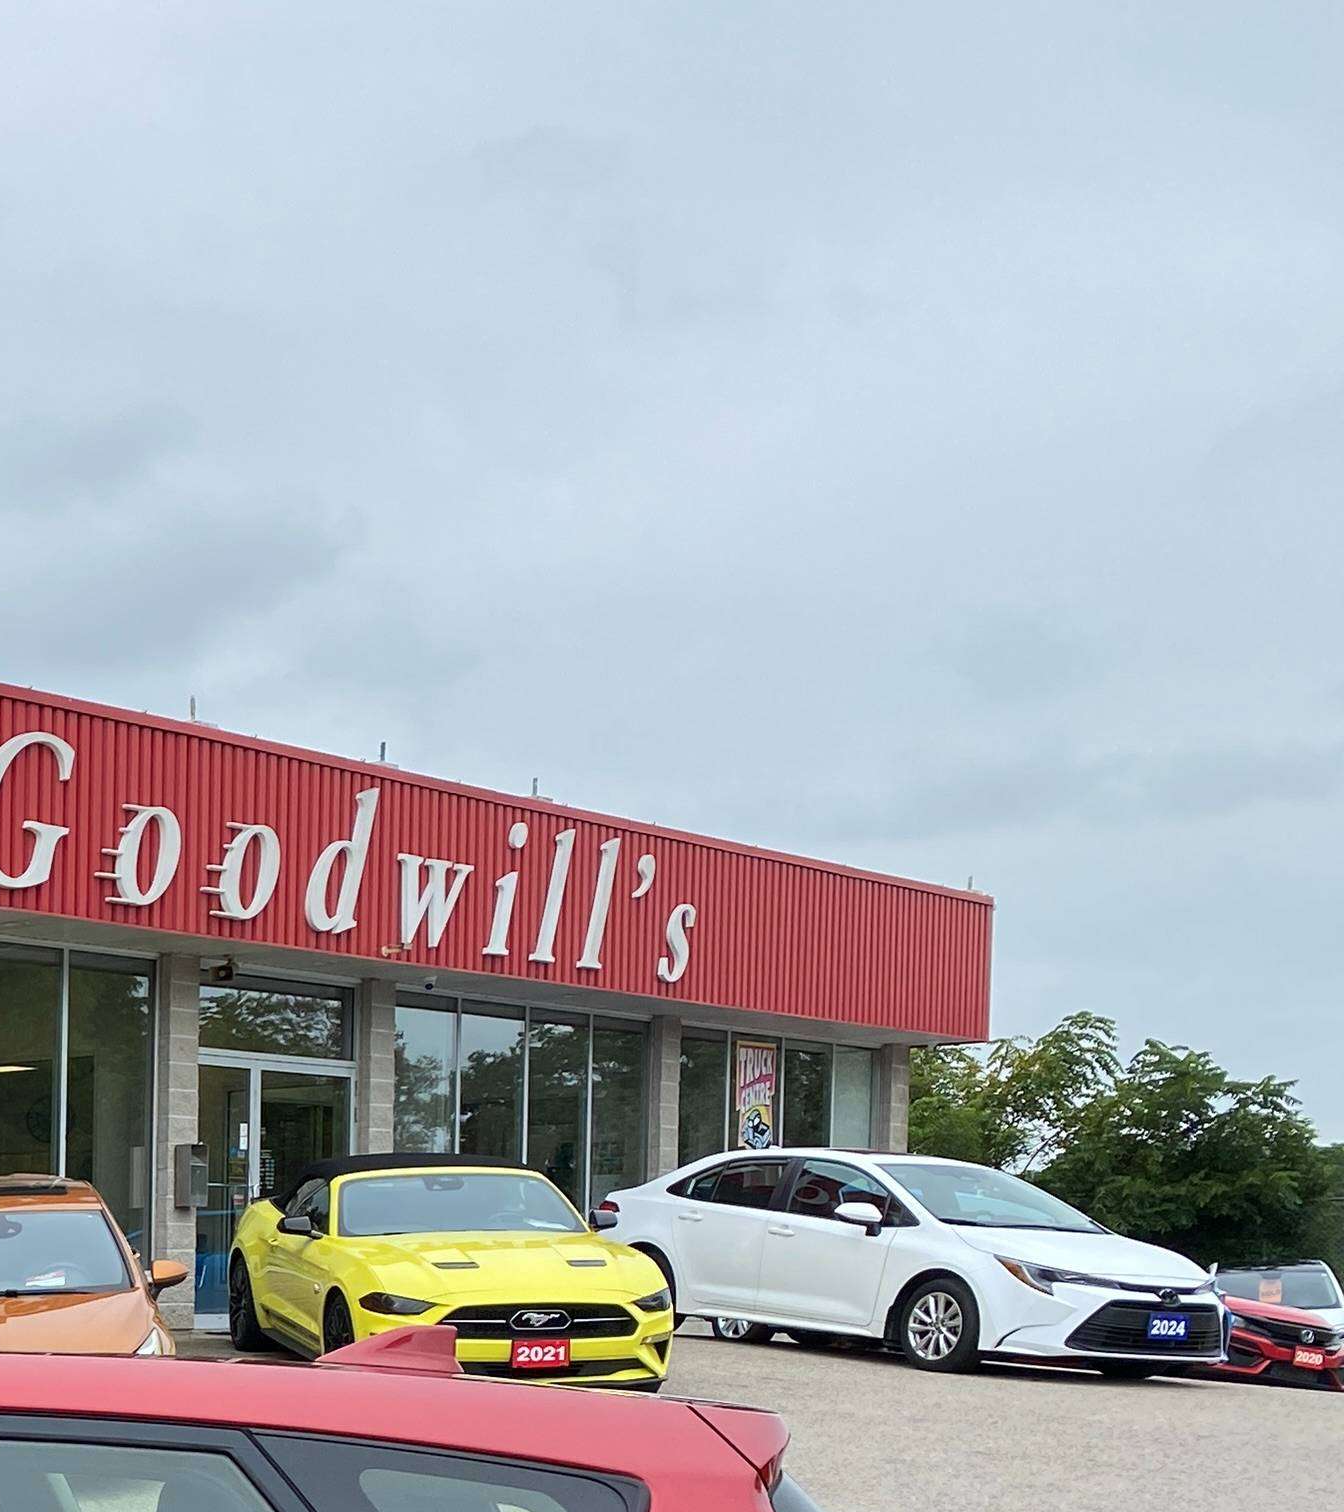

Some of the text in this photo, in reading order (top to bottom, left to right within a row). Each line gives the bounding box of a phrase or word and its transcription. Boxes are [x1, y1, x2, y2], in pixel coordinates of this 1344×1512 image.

[740, 1047, 773, 1088] TRUCK
[740, 1080, 772, 1113] CENTRE
[1150, 1319, 1186, 1336] 2024
[517, 1345, 566, 1362] 2021
[1295, 1350, 1324, 1365] 2020
